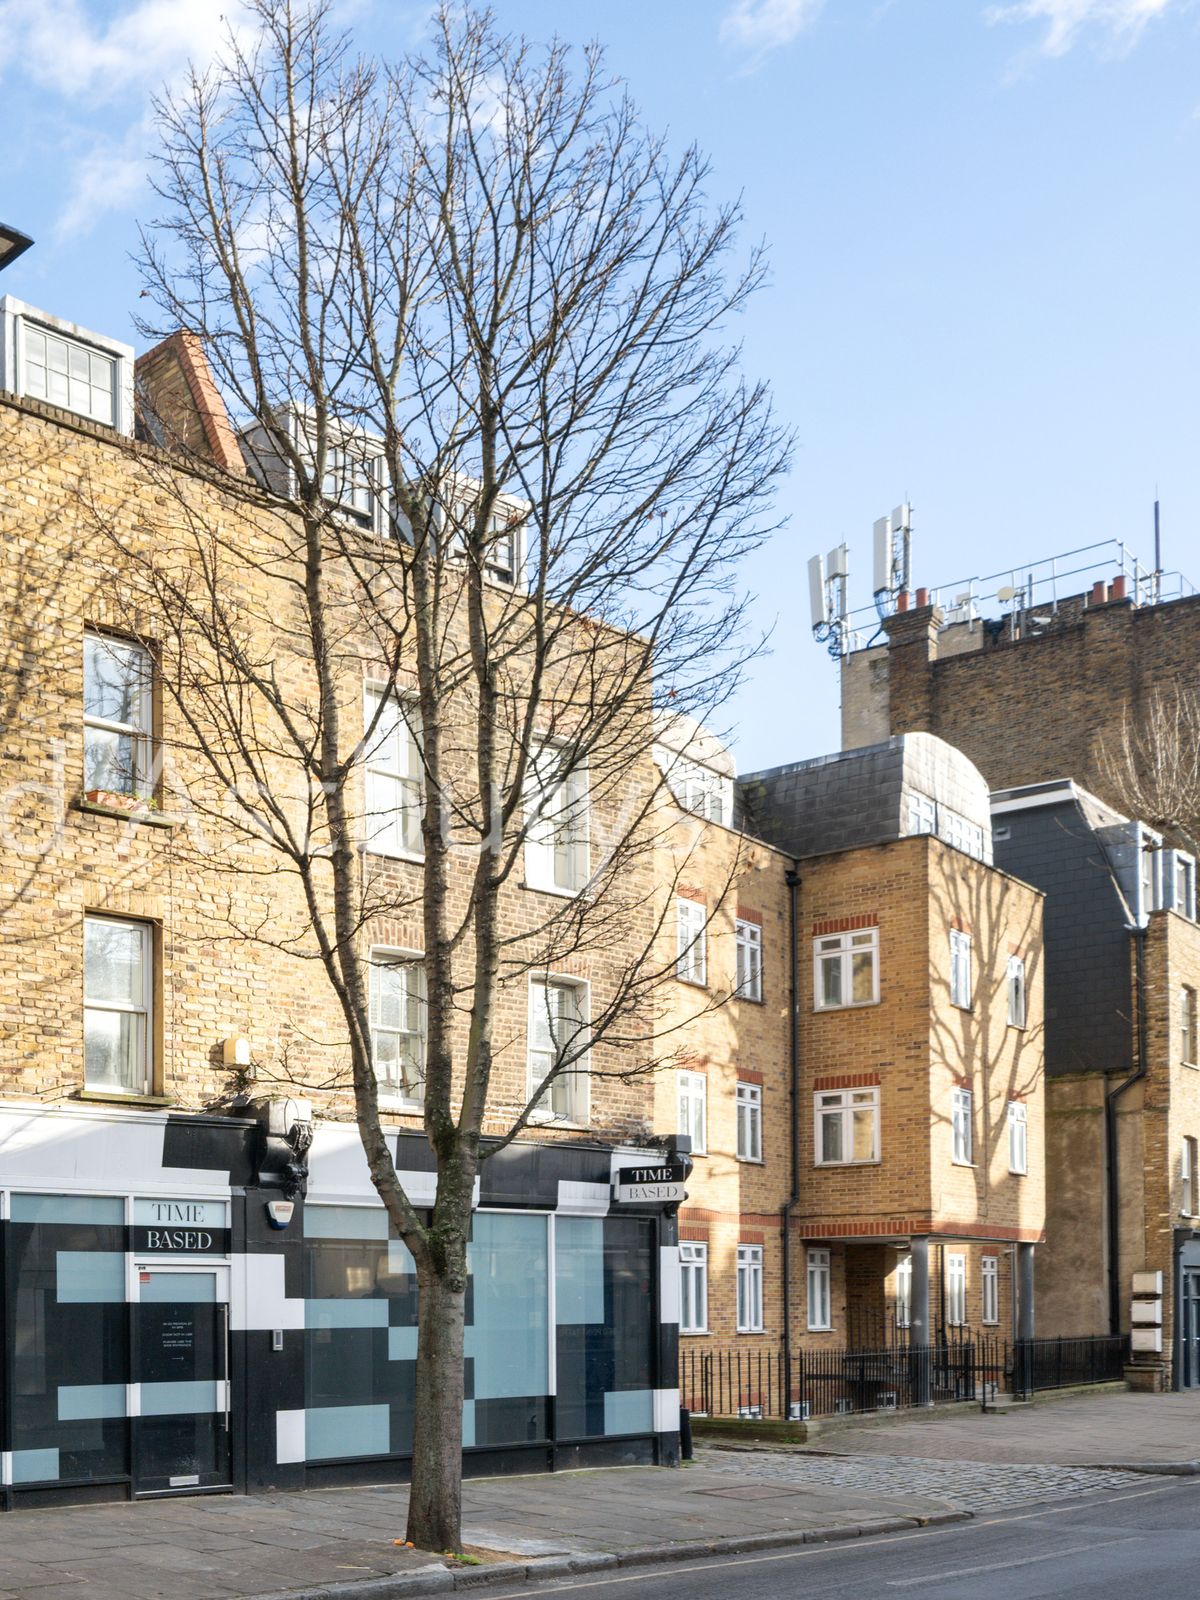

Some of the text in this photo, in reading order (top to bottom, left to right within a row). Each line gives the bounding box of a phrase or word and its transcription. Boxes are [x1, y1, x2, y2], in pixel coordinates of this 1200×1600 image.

[631, 1168, 673, 1181] TIME
[629, 1186, 678, 1199] BASED
[152, 1203, 204, 1222] TIME
[147, 1230, 212, 1249] BASED
